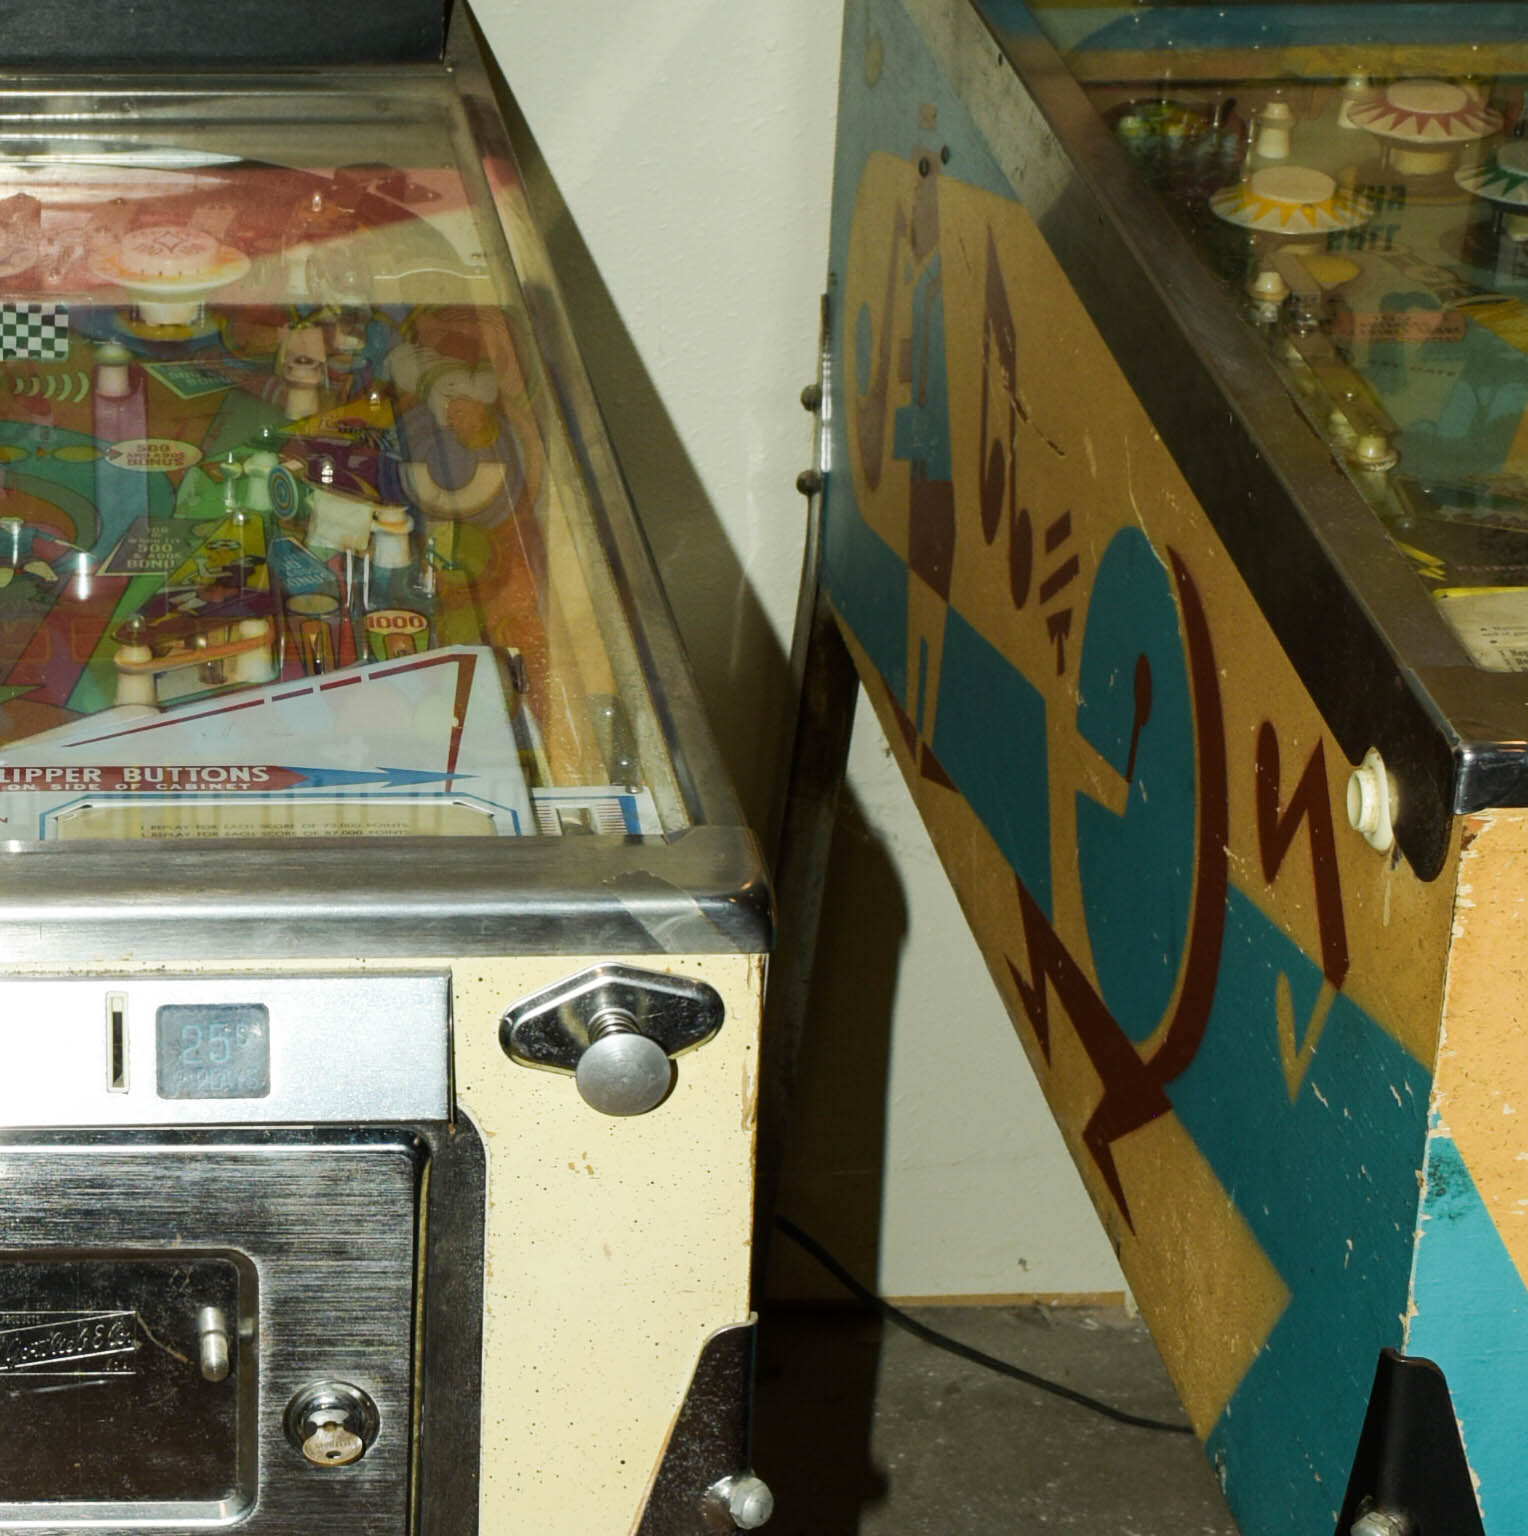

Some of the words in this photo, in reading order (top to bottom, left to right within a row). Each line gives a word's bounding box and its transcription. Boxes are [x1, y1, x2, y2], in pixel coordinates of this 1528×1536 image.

[122, 766, 270, 783] BUTTONS
[50, 783, 101, 791] SIDE
[114, 783, 141, 791] OF
[155, 783, 252, 791] CABINET
